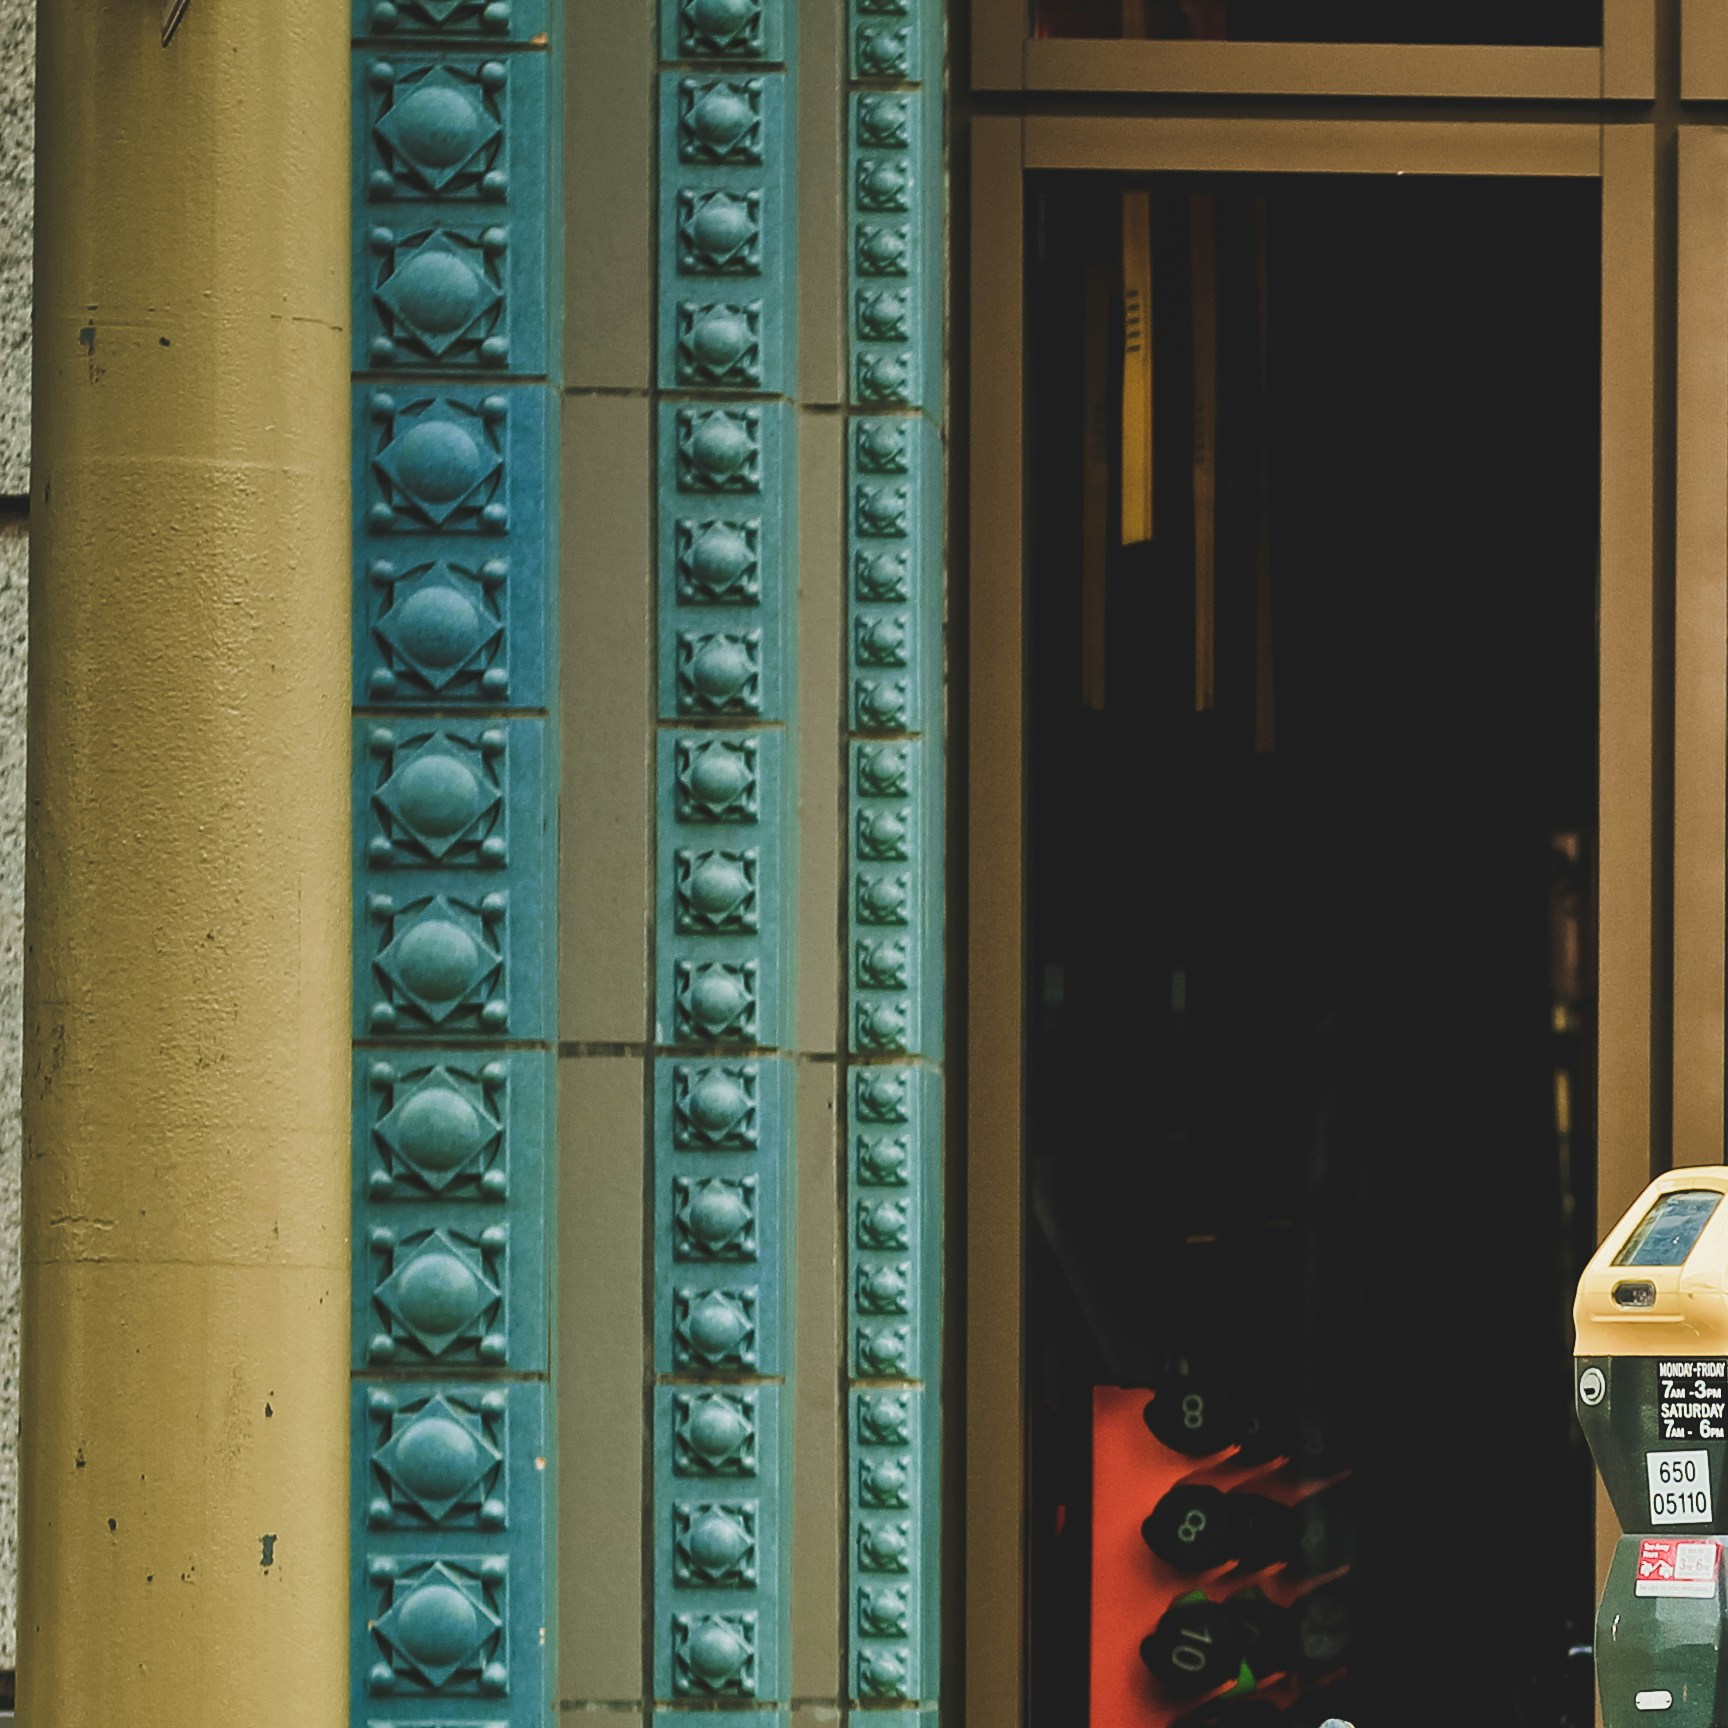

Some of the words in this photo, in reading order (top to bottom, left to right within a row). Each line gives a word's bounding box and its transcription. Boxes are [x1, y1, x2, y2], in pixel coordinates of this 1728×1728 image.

[1659, 1362, 1725, 1377] MONDAY-FRIDAY
[1661, 1380, 1686, 1399] 7AM
[1661, 1403, 1725, 1418] SATURDAY
[1663, 1419, 1685, 1438] 7AM
[1700, 1419, 1725, 1438] 6PM
[1660, 1460, 1696, 1483] 650
[1653, 1491, 1707, 1515] 05110
